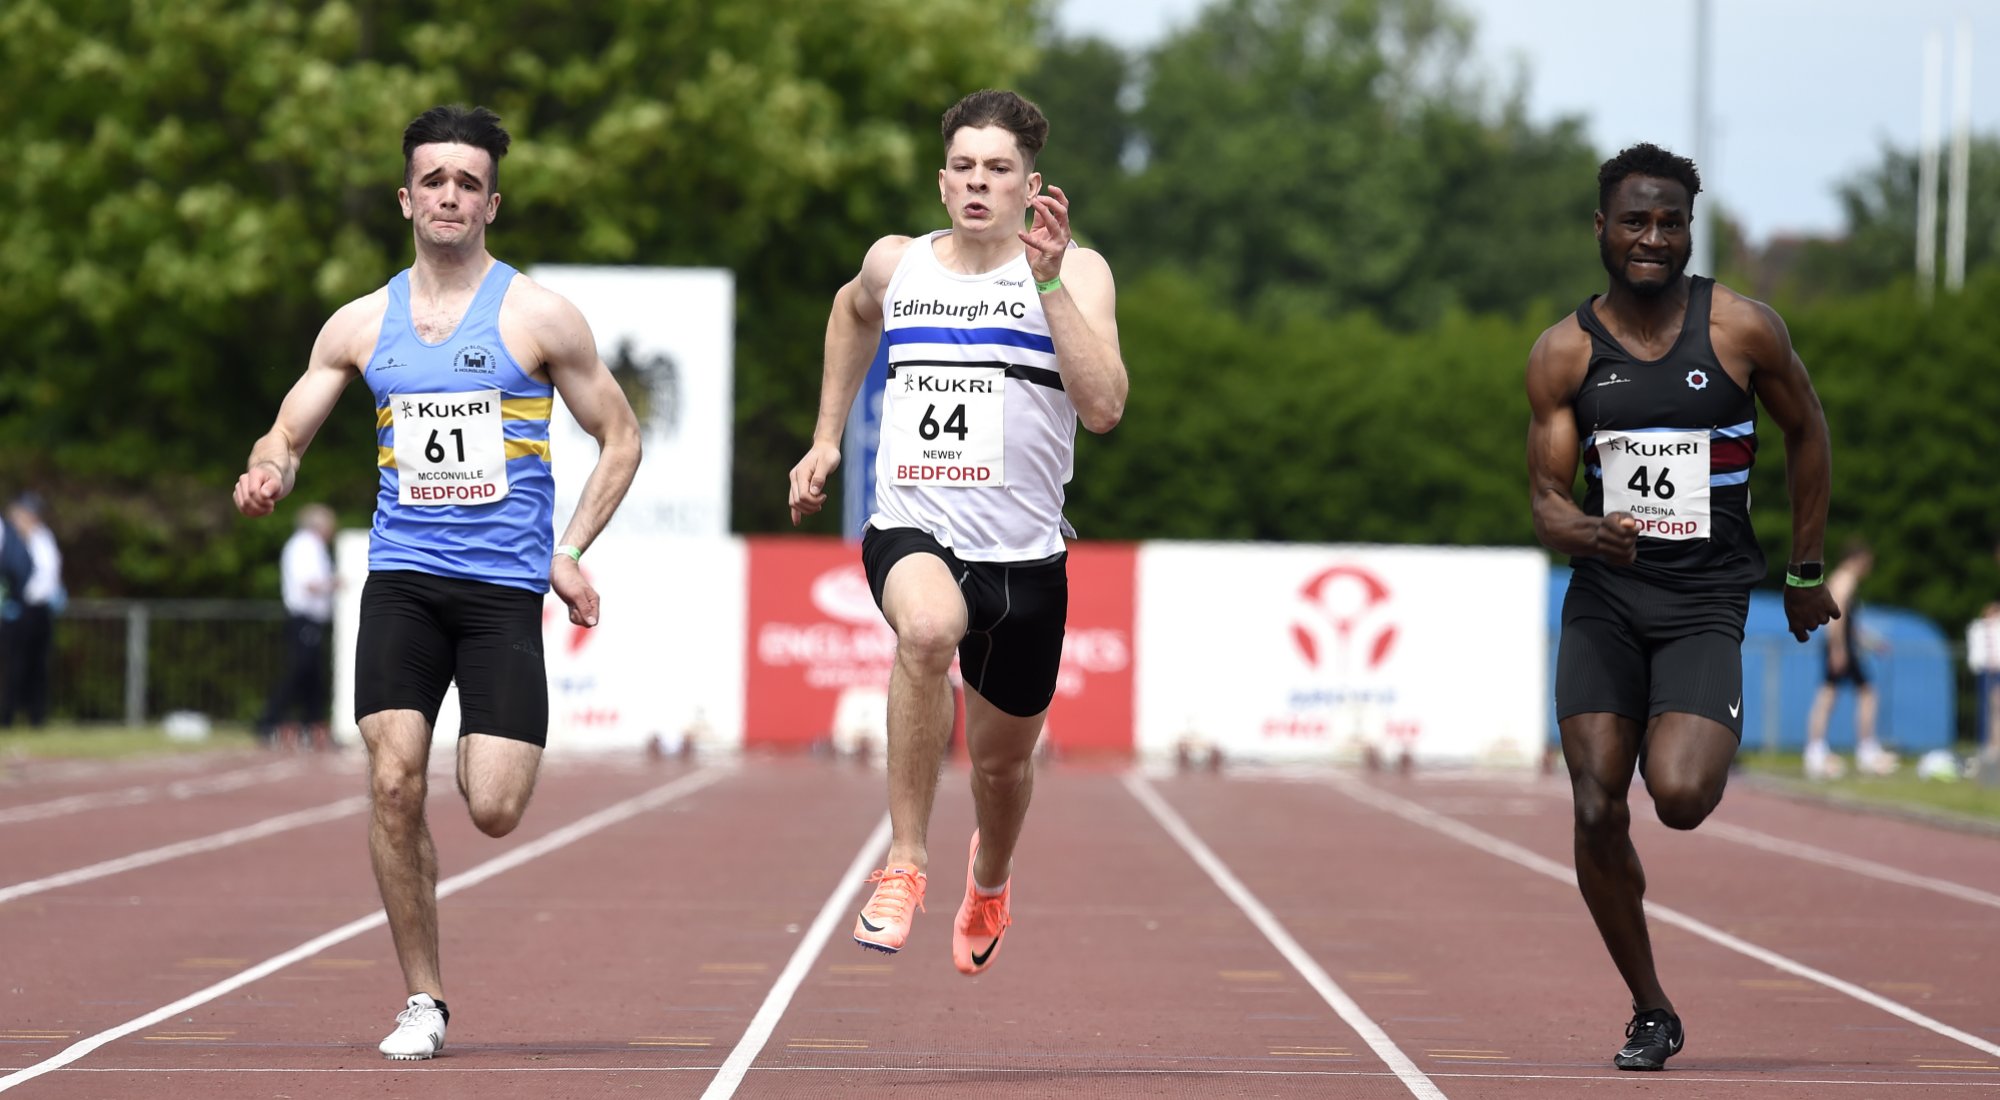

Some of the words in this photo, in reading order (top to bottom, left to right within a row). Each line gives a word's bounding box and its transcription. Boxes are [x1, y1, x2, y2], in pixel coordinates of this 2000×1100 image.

[893, 299, 989, 321] Edinburgh
[993, 300, 1026, 319] AC
[918, 375, 993, 393] KUKRI
[418, 401, 491, 418] KUKRI
[918, 403, 969, 441] 64
[424, 428, 465, 464] 61
[922, 449, 963, 460] NEWBY
[1625, 440, 1698, 457] KUKRI
[417, 469, 484, 481] MCCONVILLE
[897, 464, 991, 481] BEDFORD
[1627, 465, 1675, 500] 46
[410, 483, 496, 500] BEDFORD
[1630, 504, 1676, 517] ADESINA
[1634, 518, 1697, 535] DFORD
